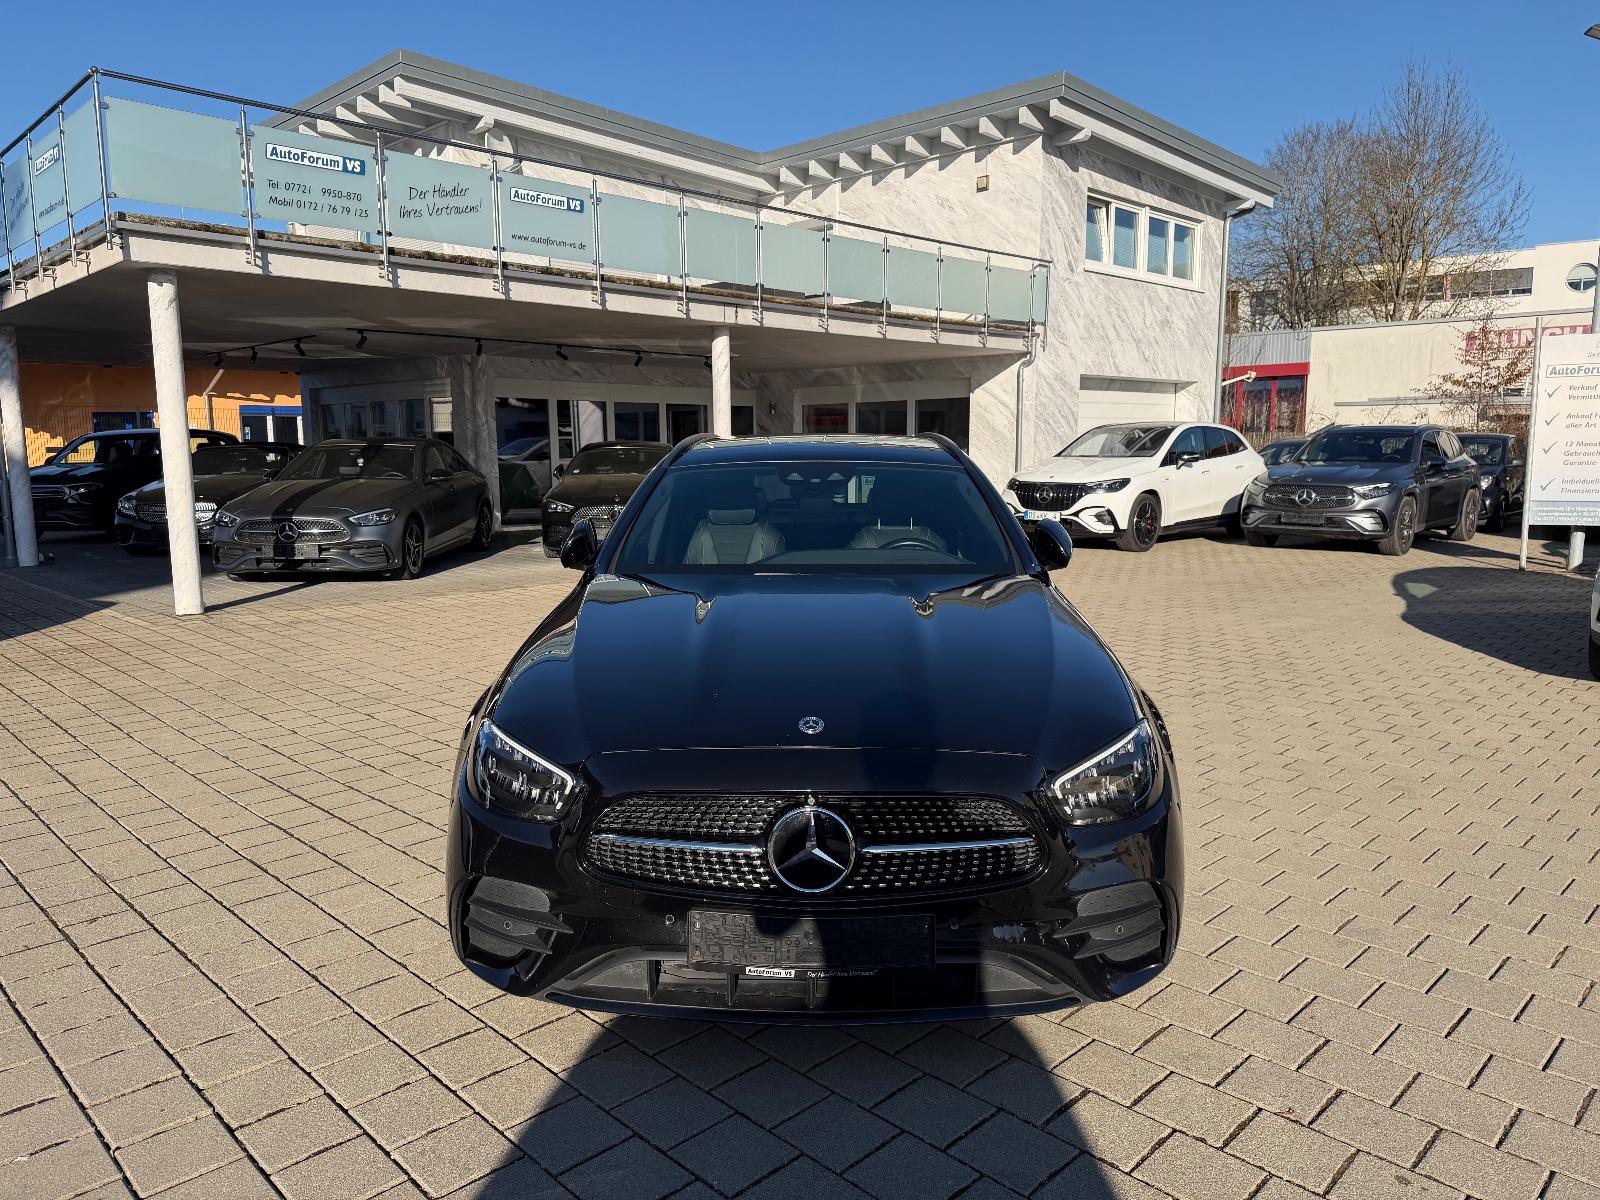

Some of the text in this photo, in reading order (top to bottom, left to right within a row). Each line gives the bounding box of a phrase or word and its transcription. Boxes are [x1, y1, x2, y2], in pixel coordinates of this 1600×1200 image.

[270, 146, 361, 173] AutoForum VS
[267, 179, 281, 190] Tel.
[321, 187, 362, 202] 9950-870
[408, 182, 470, 201] Der Händler
[513, 189, 581, 211] AutoForum VS
[268, 195, 294, 208] Mobil
[296, 199, 318, 211] 0172
[327, 204, 338, 214] 76
[341, 205, 351, 216] 79
[399, 195, 483, 219] Ihres Vertrauens!
[511, 233, 587, 251] www.autoforum-vs.de
[1568, 383, 1599, 391] Verkauf
[1566, 412, 1593, 420] Ankauf
